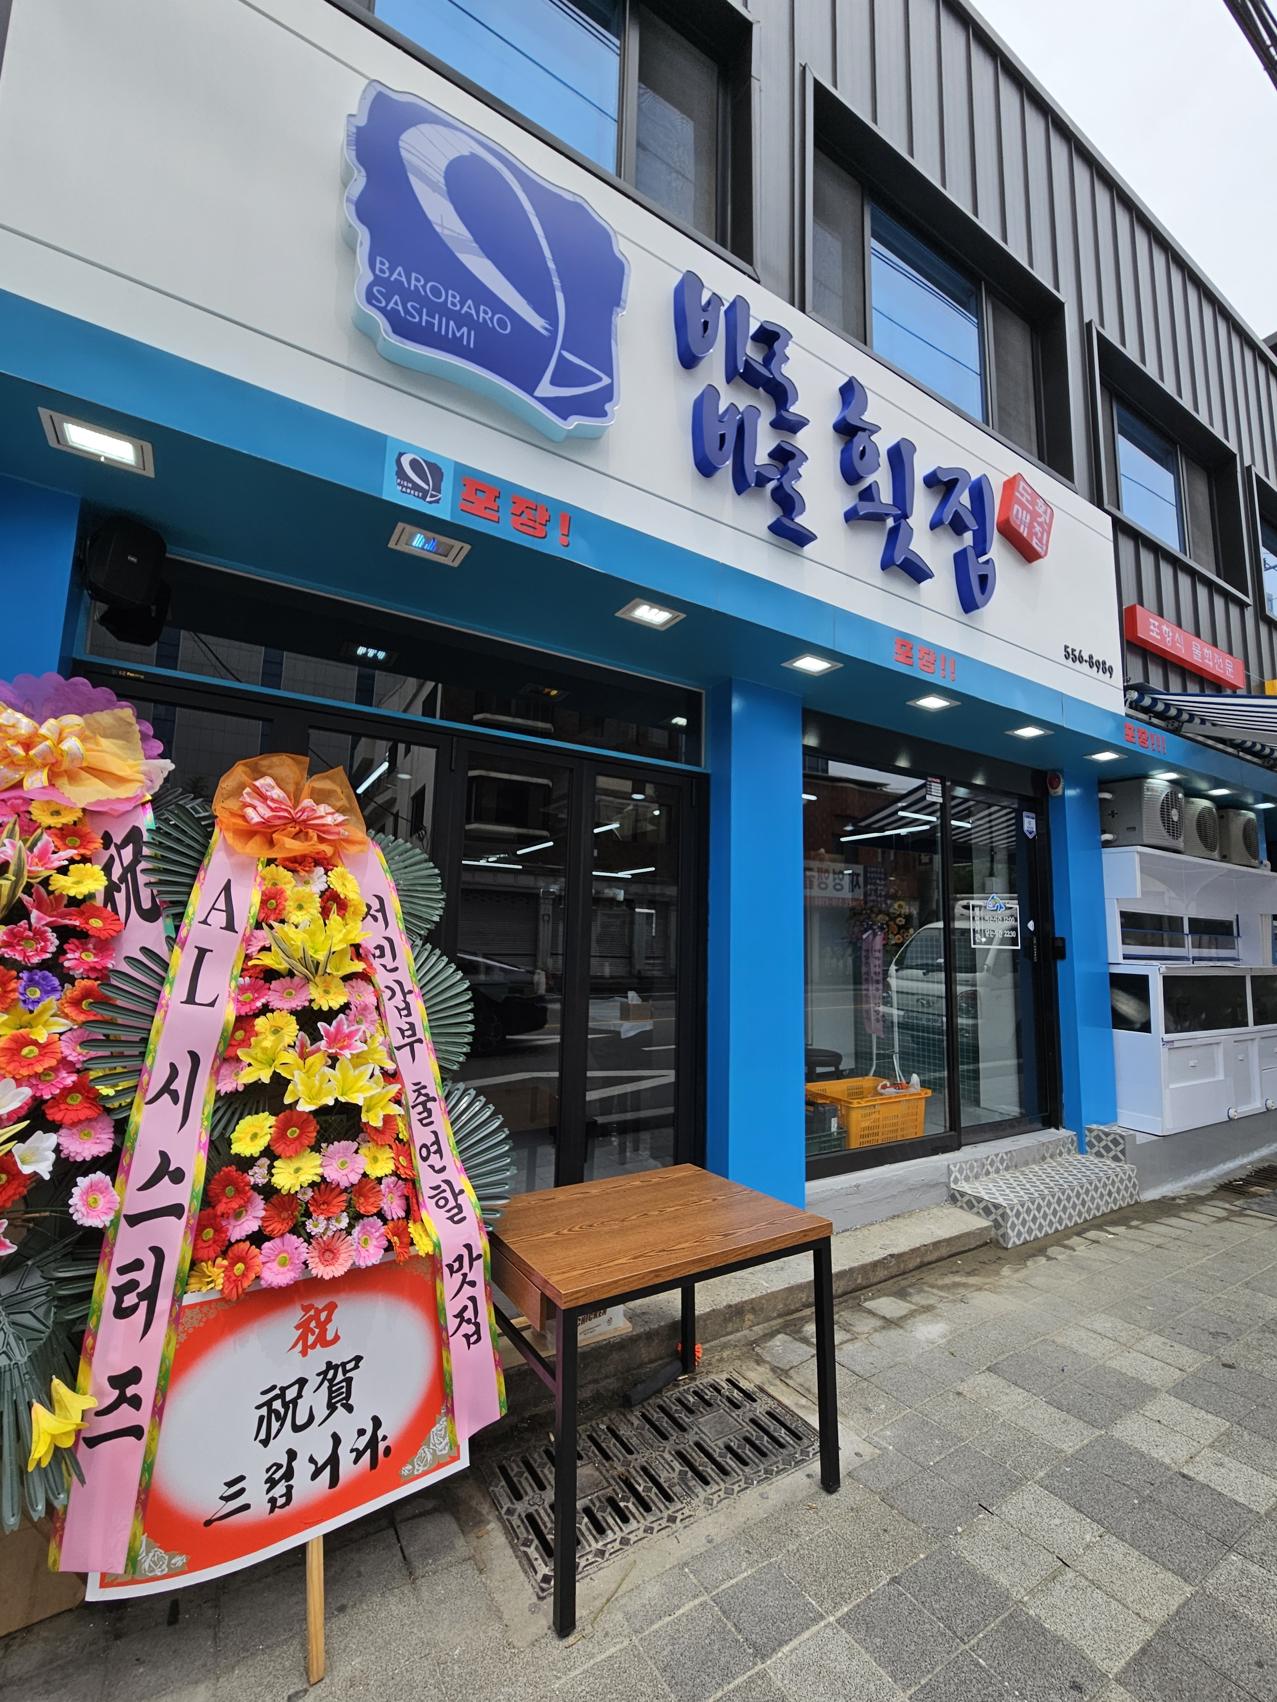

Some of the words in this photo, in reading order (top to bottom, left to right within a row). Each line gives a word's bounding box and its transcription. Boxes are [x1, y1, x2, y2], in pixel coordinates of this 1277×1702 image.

[371, 286, 475, 349] SASHIMI
[375, 256, 511, 335] BAROBARO
[460, 476, 572, 548] 포장!
[833, 376, 997, 615] 횟집
[894, 637, 957, 682] 포장!!
[1063, 644, 1115, 679] 556-8989
[1149, 617, 1185, 654] 포항식
[362, 894, 425, 1063] 서민갑부
[411, 1081, 467, 1225] 출연할
[445, 1242, 484, 1351] 맛집
[288, 1301, 341, 1358] 祝
[254, 1355, 365, 1448] 祝賀
